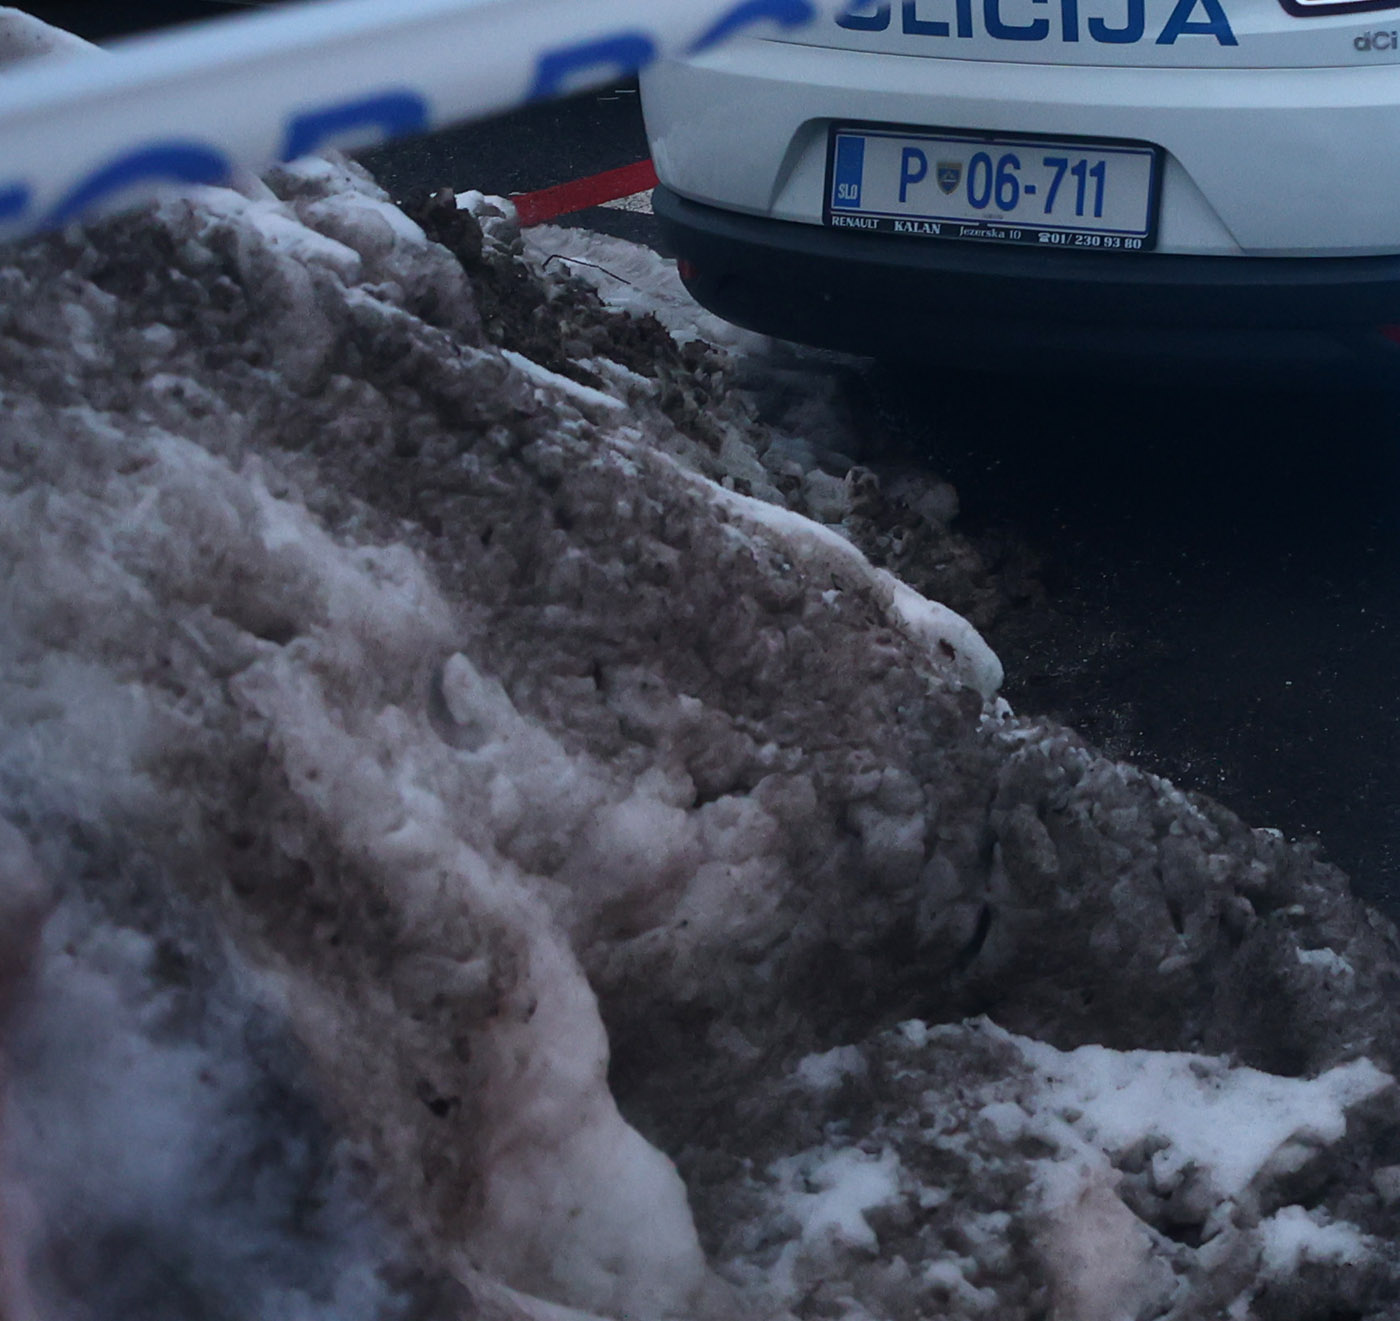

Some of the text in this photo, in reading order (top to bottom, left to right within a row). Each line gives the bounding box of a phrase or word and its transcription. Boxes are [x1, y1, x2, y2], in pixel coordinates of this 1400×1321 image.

[1353, 30, 1398, 51] dCi
[838, 183, 858, 200] SLO
[899, 147, 1106, 218] P 06-711
[832, 216, 879, 229] RENAULT
[894, 221, 942, 234] KALAN
[1074, 235, 1101, 247] 230
[1103, 237, 1121, 248] 93
[1124, 238, 1142, 250] 80
